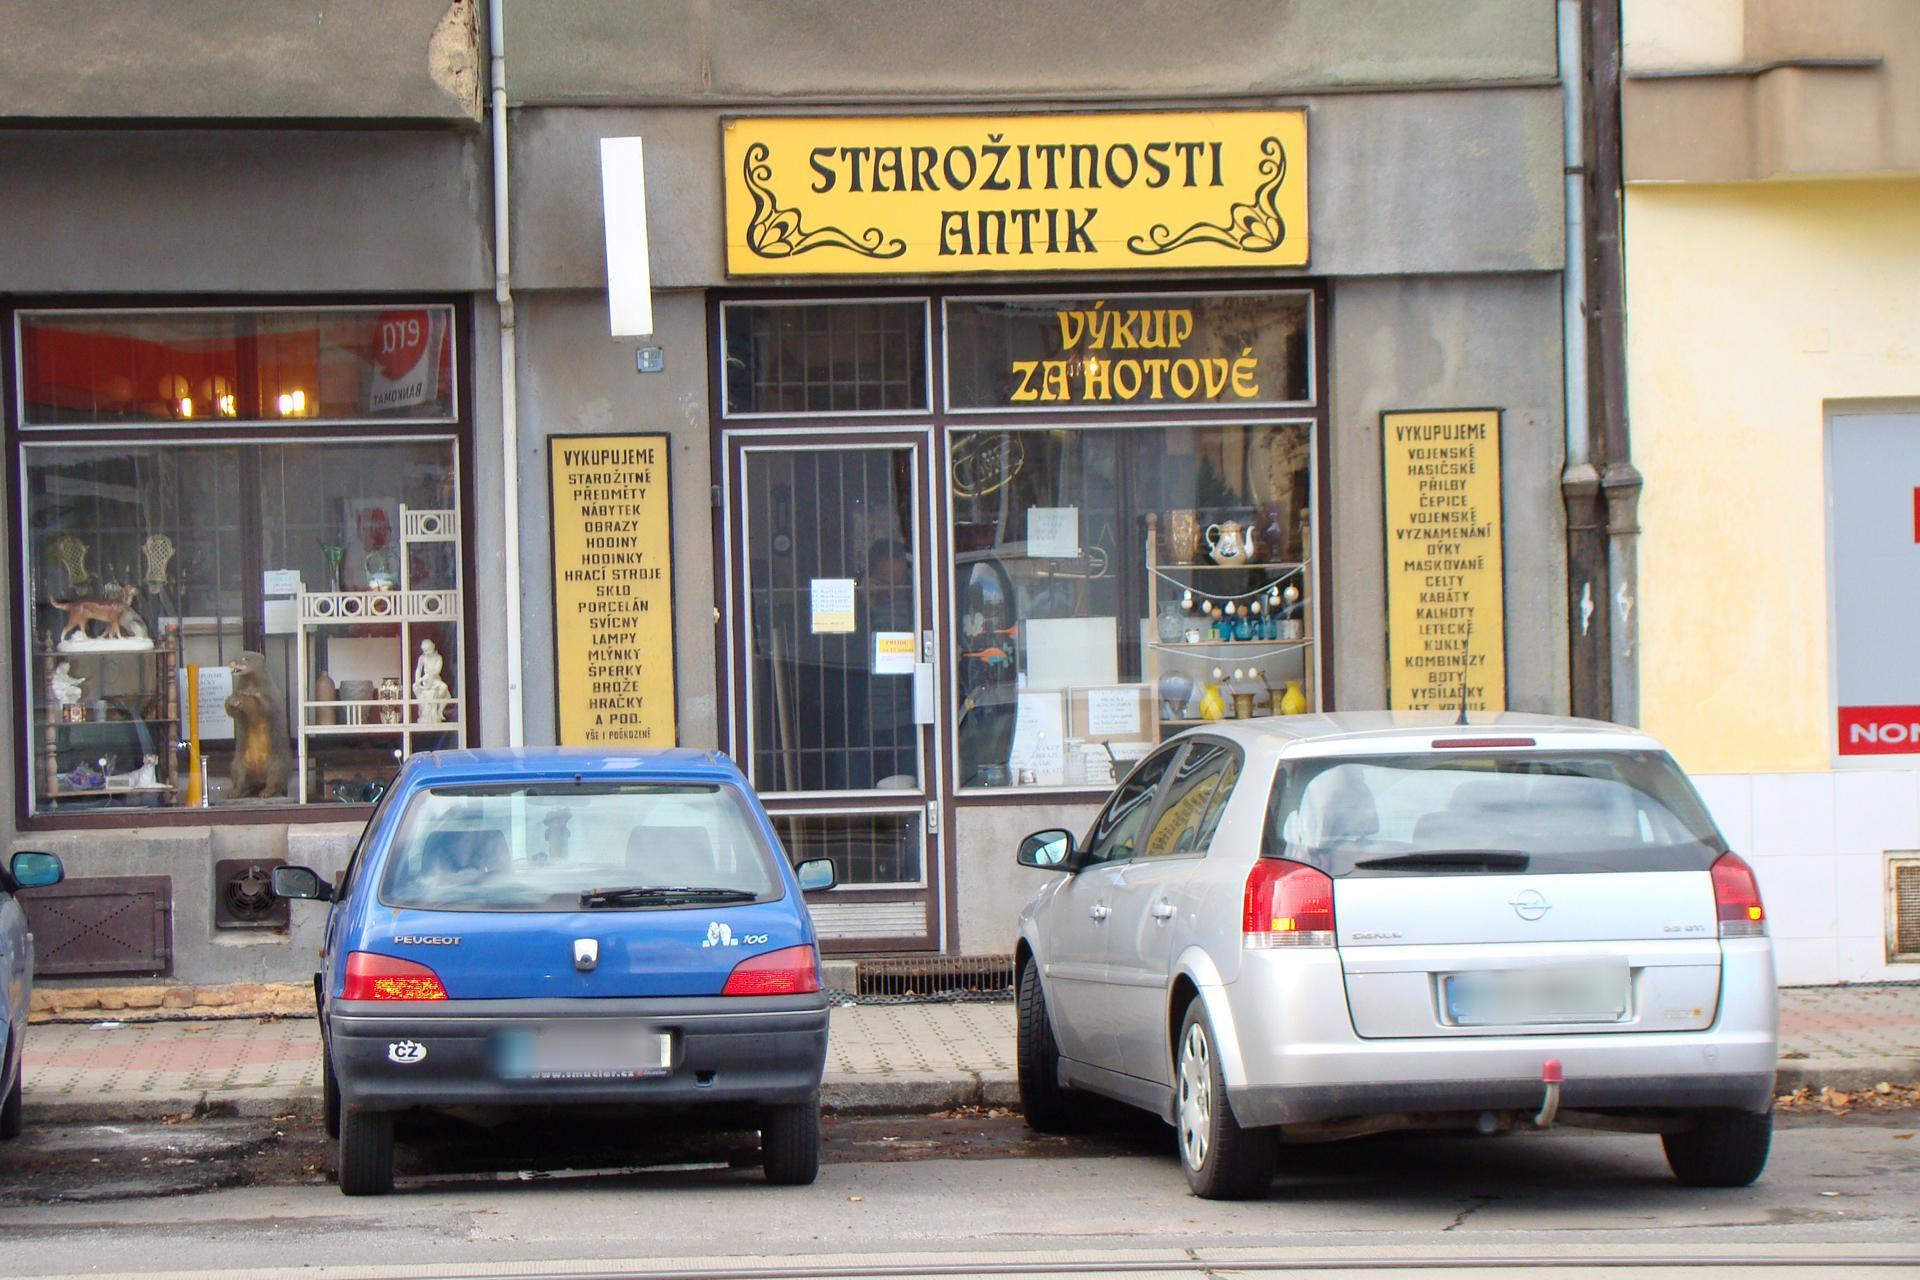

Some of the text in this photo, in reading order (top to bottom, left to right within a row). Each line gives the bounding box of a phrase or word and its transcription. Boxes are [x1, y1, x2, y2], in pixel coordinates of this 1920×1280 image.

[808, 134, 1224, 195] STAROŽITNOSTI
[938, 208, 1099, 255] ANTIK
[1057, 301, 1194, 351] VÝKUP
[1011, 348, 1259, 401] ZA HOTOVÉ
[1396, 424, 1486, 441] VYKUPUJEME
[564, 448, 655, 466] VYKUPUJEME
[1408, 443, 1477, 460] VOJENSKÉ
[1408, 460, 1477, 476] HASIČSKÉ
[568, 469, 652, 485] STAROŽITNÉ
[1419, 477, 1467, 491] PŘILBY
[574, 485, 647, 501] PŘEDMĚTY
[1419, 493, 1468, 508] ČEPICE
[582, 502, 641, 517] NÁBYTEK
[1410, 507, 1477, 524] VOJENSKÉ
[585, 520, 639, 533] OBRAZY
[1396, 522, 1492, 540] VYZNAMENÁNÍ
[586, 536, 638, 549] HODINY
[1427, 540, 1461, 556] DÝKY
[582, 552, 643, 565] HODINKY
[565, 566, 662, 581] HRACÍ STROJE
[1425, 575, 1464, 587] CELTY
[597, 585, 631, 597] SKLO
[1419, 588, 1470, 604] KABÁTY
[578, 597, 649, 613] PORCELÁN
[1416, 607, 1475, 620] KALHOTY
[589, 614, 639, 629] SVÍCNY
[1419, 619, 1474, 635] LETECKÉ
[592, 633, 636, 645] LAMPY
[1424, 639, 1468, 651] KUKLY
[588, 646, 641, 661] MLÝNKY
[1405, 651, 1486, 667] KOMBINÉZY
[588, 662, 642, 677] ŠPERKY
[1428, 671, 1465, 683] BOTY
[592, 678, 639, 693] BROŽE
[1411, 683, 1485, 699] VYSÍLAČKY
[589, 693, 643, 709] HRAČKY
[595, 713, 642, 725] A POD.
[585, 729, 600, 740] VŠE
[394, 935, 462, 945] PEUGEOT
[743, 933, 769, 945] 106
[395, 1045, 419, 1058] CZ
